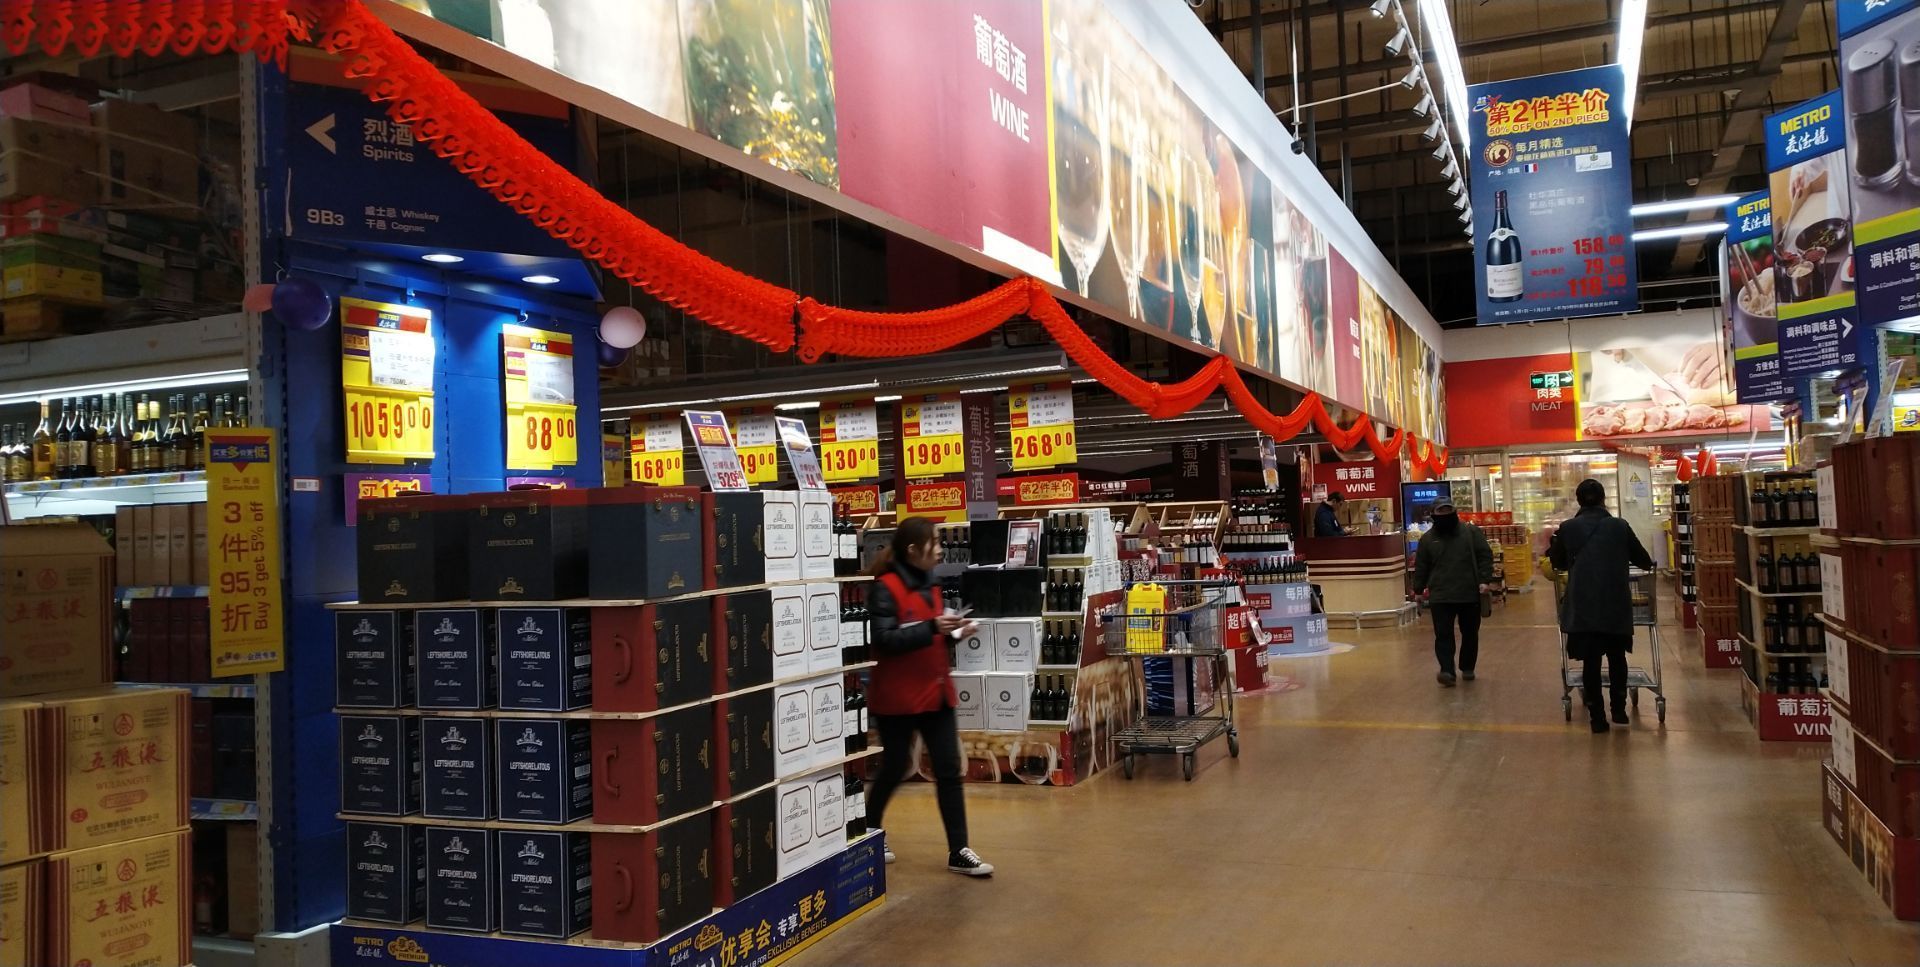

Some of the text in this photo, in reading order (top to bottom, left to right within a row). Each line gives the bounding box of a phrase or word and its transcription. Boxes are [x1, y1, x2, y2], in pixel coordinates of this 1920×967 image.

[973, 13, 1028, 95] 葡萄酒
[989, 87, 1031, 143] WINE
[1489, 90, 1607, 126] 第2件半价
[1513, 123, 1532, 132] OFF
[1534, 120, 1550, 128] ON
[1552, 117, 1574, 127] 2ND
[1576, 113, 1608, 124] PIECE
[1780, 105, 1831, 136] METRO
[363, 117, 414, 147] 烈酒
[363, 145, 414, 163] Spirits
[1515, 137, 1564, 153] 每月精选
[306, 208, 345, 227] 9B3
[401, 209, 440, 223] Whiskey
[391, 220, 425, 233] Cognac
[1531, 400, 1563, 411] MEAT
[1336, 466, 1375, 480] 葡萄酒
[911, 487, 961, 502] 第2件半价
[1021, 480, 1073, 495] 第2件半价
[1345, 481, 1376, 493] WINE
[834, 490, 875, 506] 2件半价
[250, 500, 271, 631] Buy 3 get 5% off
[1777, 698, 1832, 717] 葡萄
[353, 936, 384, 947] METRO
[767, 935, 801, 959] EXCLUSIVE
[800, 917, 828, 940] BENEFITS
[669, 938, 692, 957] METRO
[398, 953, 426, 961] PREMIUM
